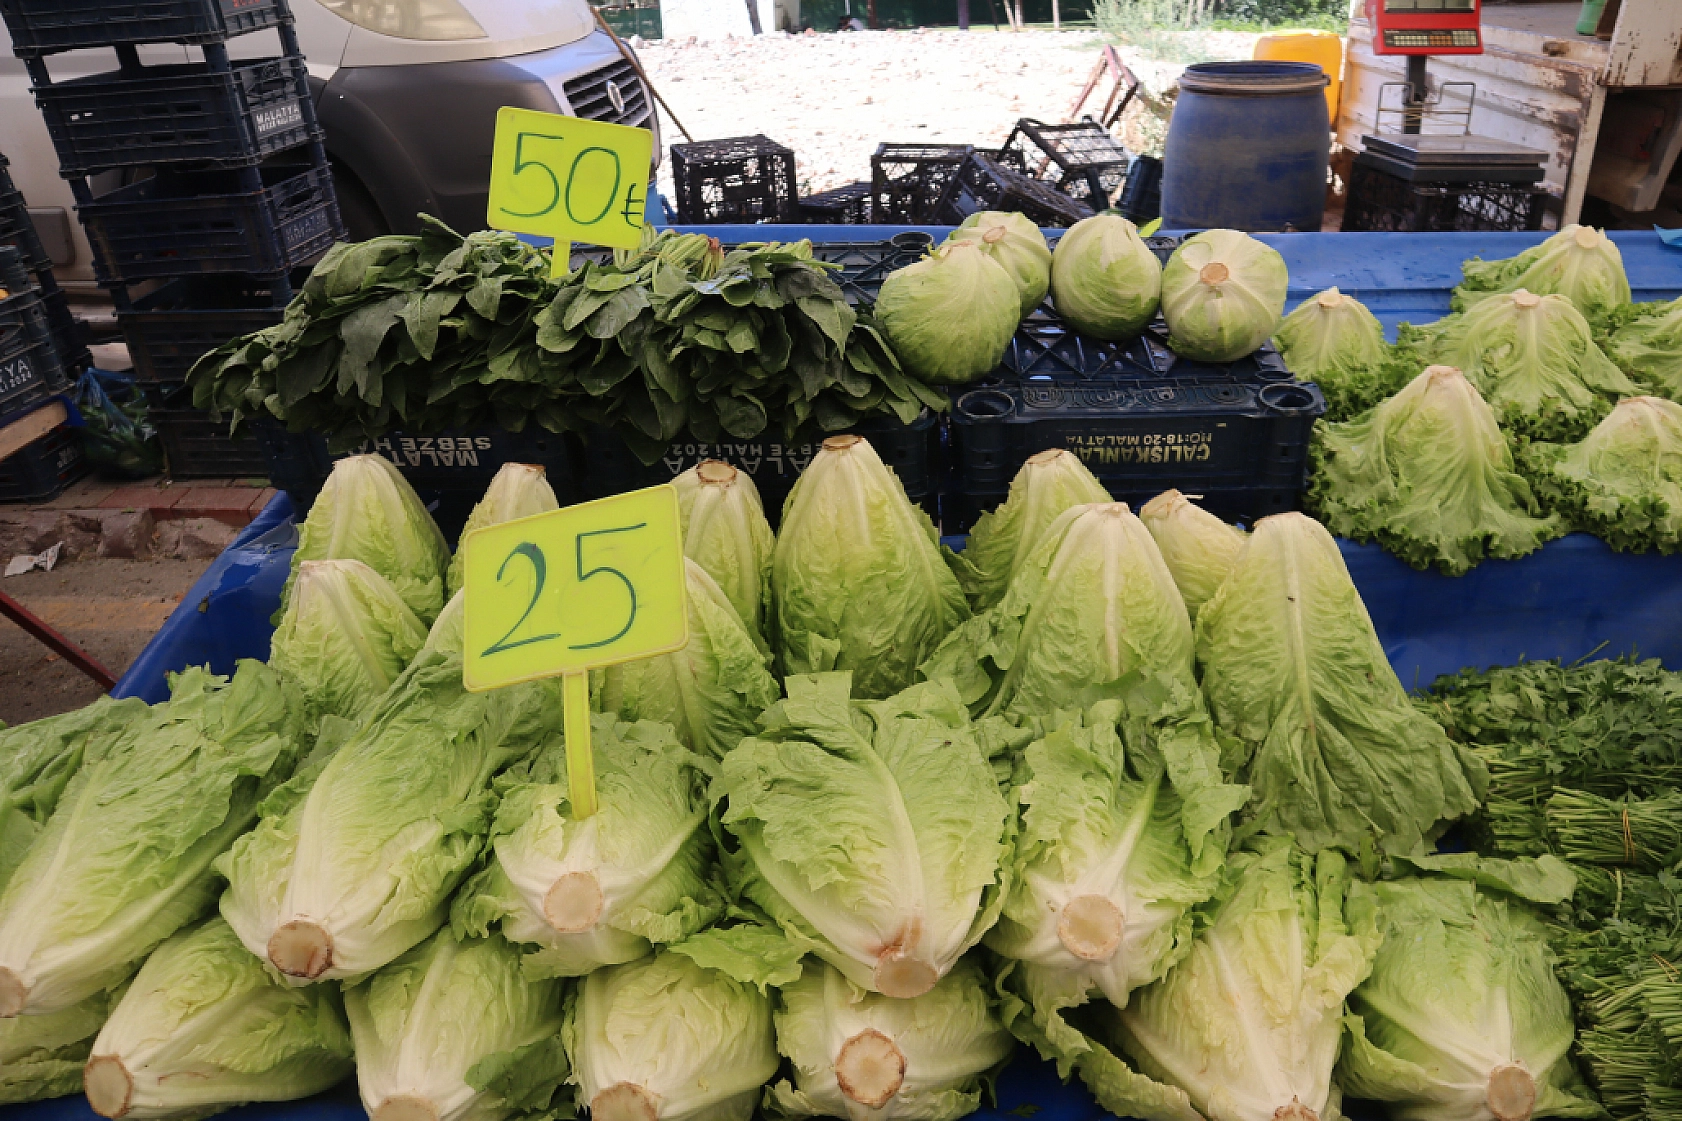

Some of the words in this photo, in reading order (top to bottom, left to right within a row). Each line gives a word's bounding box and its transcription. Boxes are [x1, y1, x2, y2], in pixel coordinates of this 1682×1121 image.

[399, 437, 492, 451] SEBZE
[1065, 435, 1140, 446] MALATYA
[665, 443, 709, 457] 202
[479, 522, 647, 658] 25
